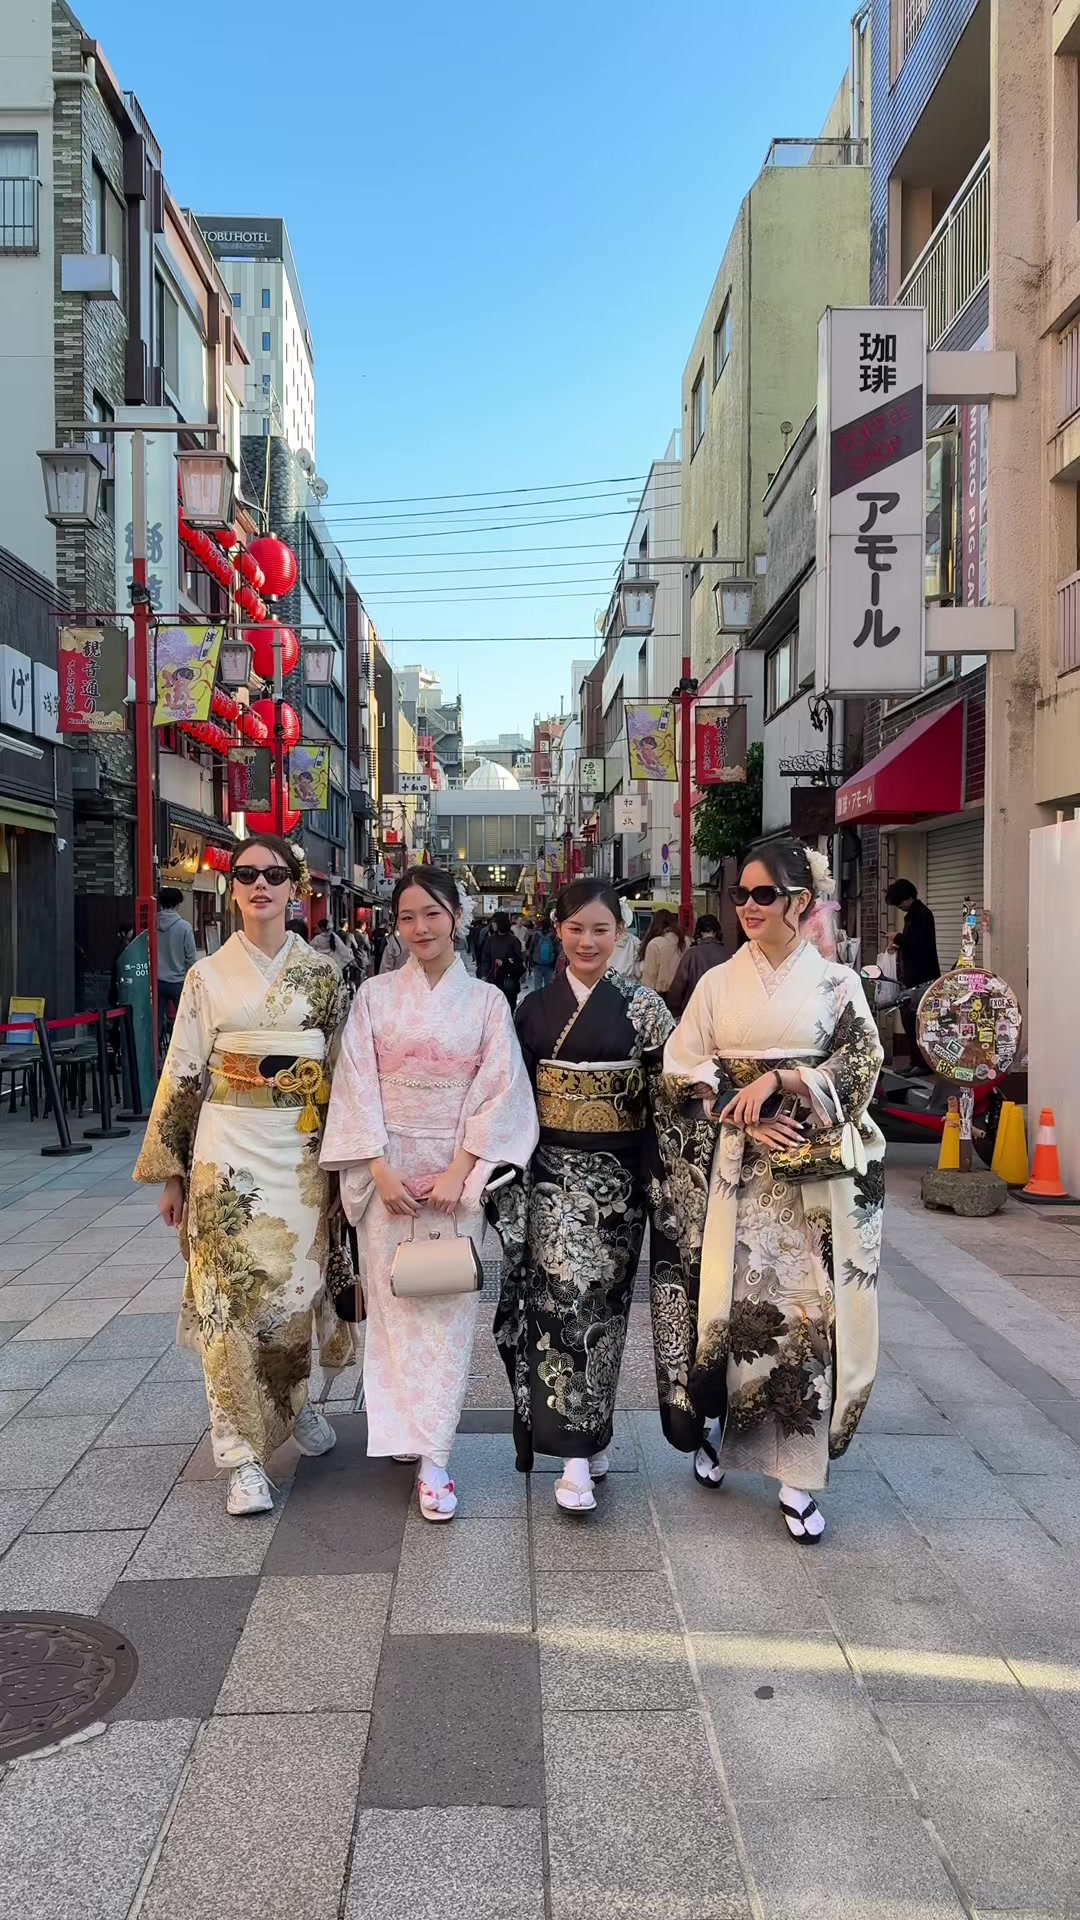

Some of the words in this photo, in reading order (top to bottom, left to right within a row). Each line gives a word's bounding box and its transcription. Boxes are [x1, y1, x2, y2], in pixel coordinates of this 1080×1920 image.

[202, 231, 232, 242] TOBU
[234, 231, 271, 242] HOTEL
[859, 333, 896, 393] 珈琲
[838, 401, 912, 453] COFFEE
[850, 435, 901, 475] SHOP
[969, 405, 977, 498] MICRO
[968, 506, 976, 554] PIG
[853, 492, 901, 648] アモール
[81, 640, 101, 714] 観音通り
